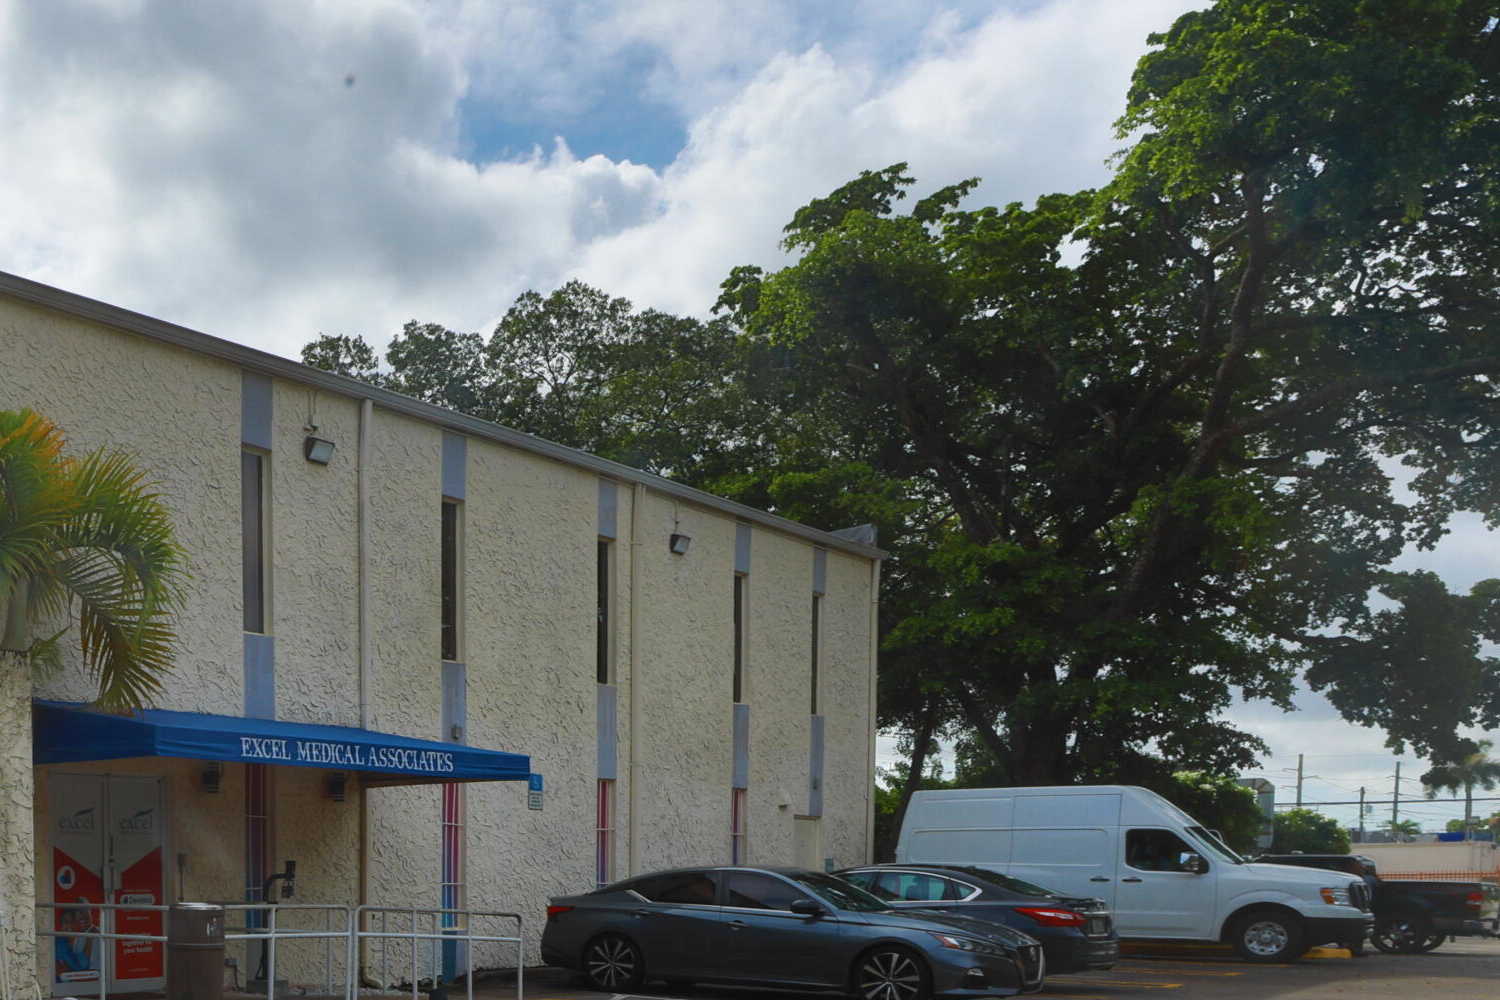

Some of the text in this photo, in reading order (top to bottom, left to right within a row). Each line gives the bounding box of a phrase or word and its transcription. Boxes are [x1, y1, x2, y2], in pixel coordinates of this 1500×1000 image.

[240, 737, 454, 772] EXCEL MEDICAL ASSOCIATES
[59, 814, 94, 829] excel
[119, 815, 153, 829] excel
